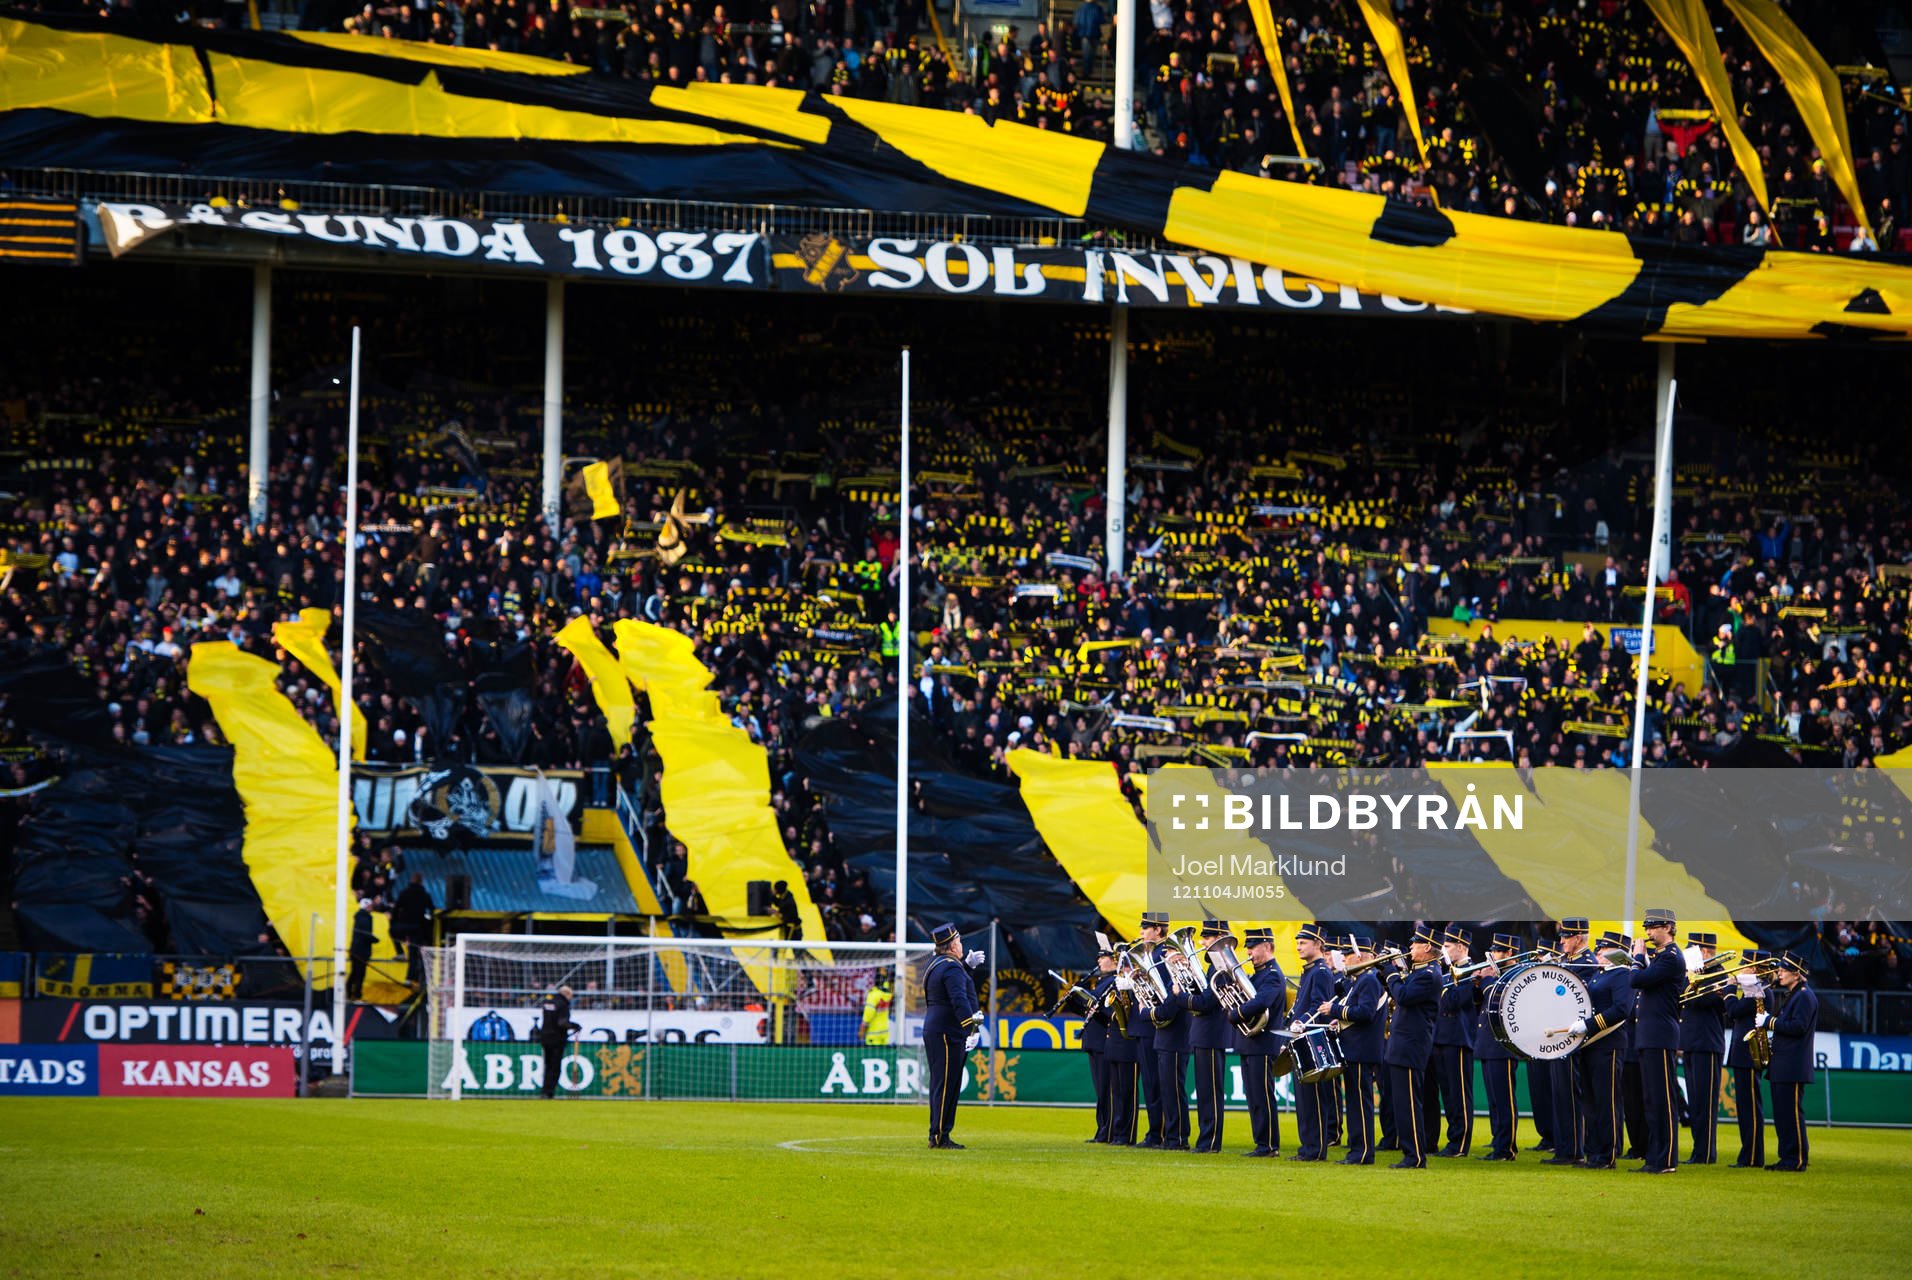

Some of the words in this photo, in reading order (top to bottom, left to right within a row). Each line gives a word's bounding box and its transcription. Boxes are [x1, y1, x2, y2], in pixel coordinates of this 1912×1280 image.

[559, 226, 761, 283] 1937
[868, 237, 1046, 296] SOL
[1083, 249, 1477, 314] INVIC
[1111, 518, 1121, 533] 5
[1506, 973, 1538, 1034] STOCKHOLMS
[1542, 971, 1585, 1005] MUSIKKÅR
[84, 1004, 336, 1043] OPTIMERA
[310, 1047, 349, 1061] pros
[1539, 1034, 1578, 1054] KRONOR
[121, 1060, 271, 1088] KANSAS
[441, 1046, 595, 1091] ÅBRO
